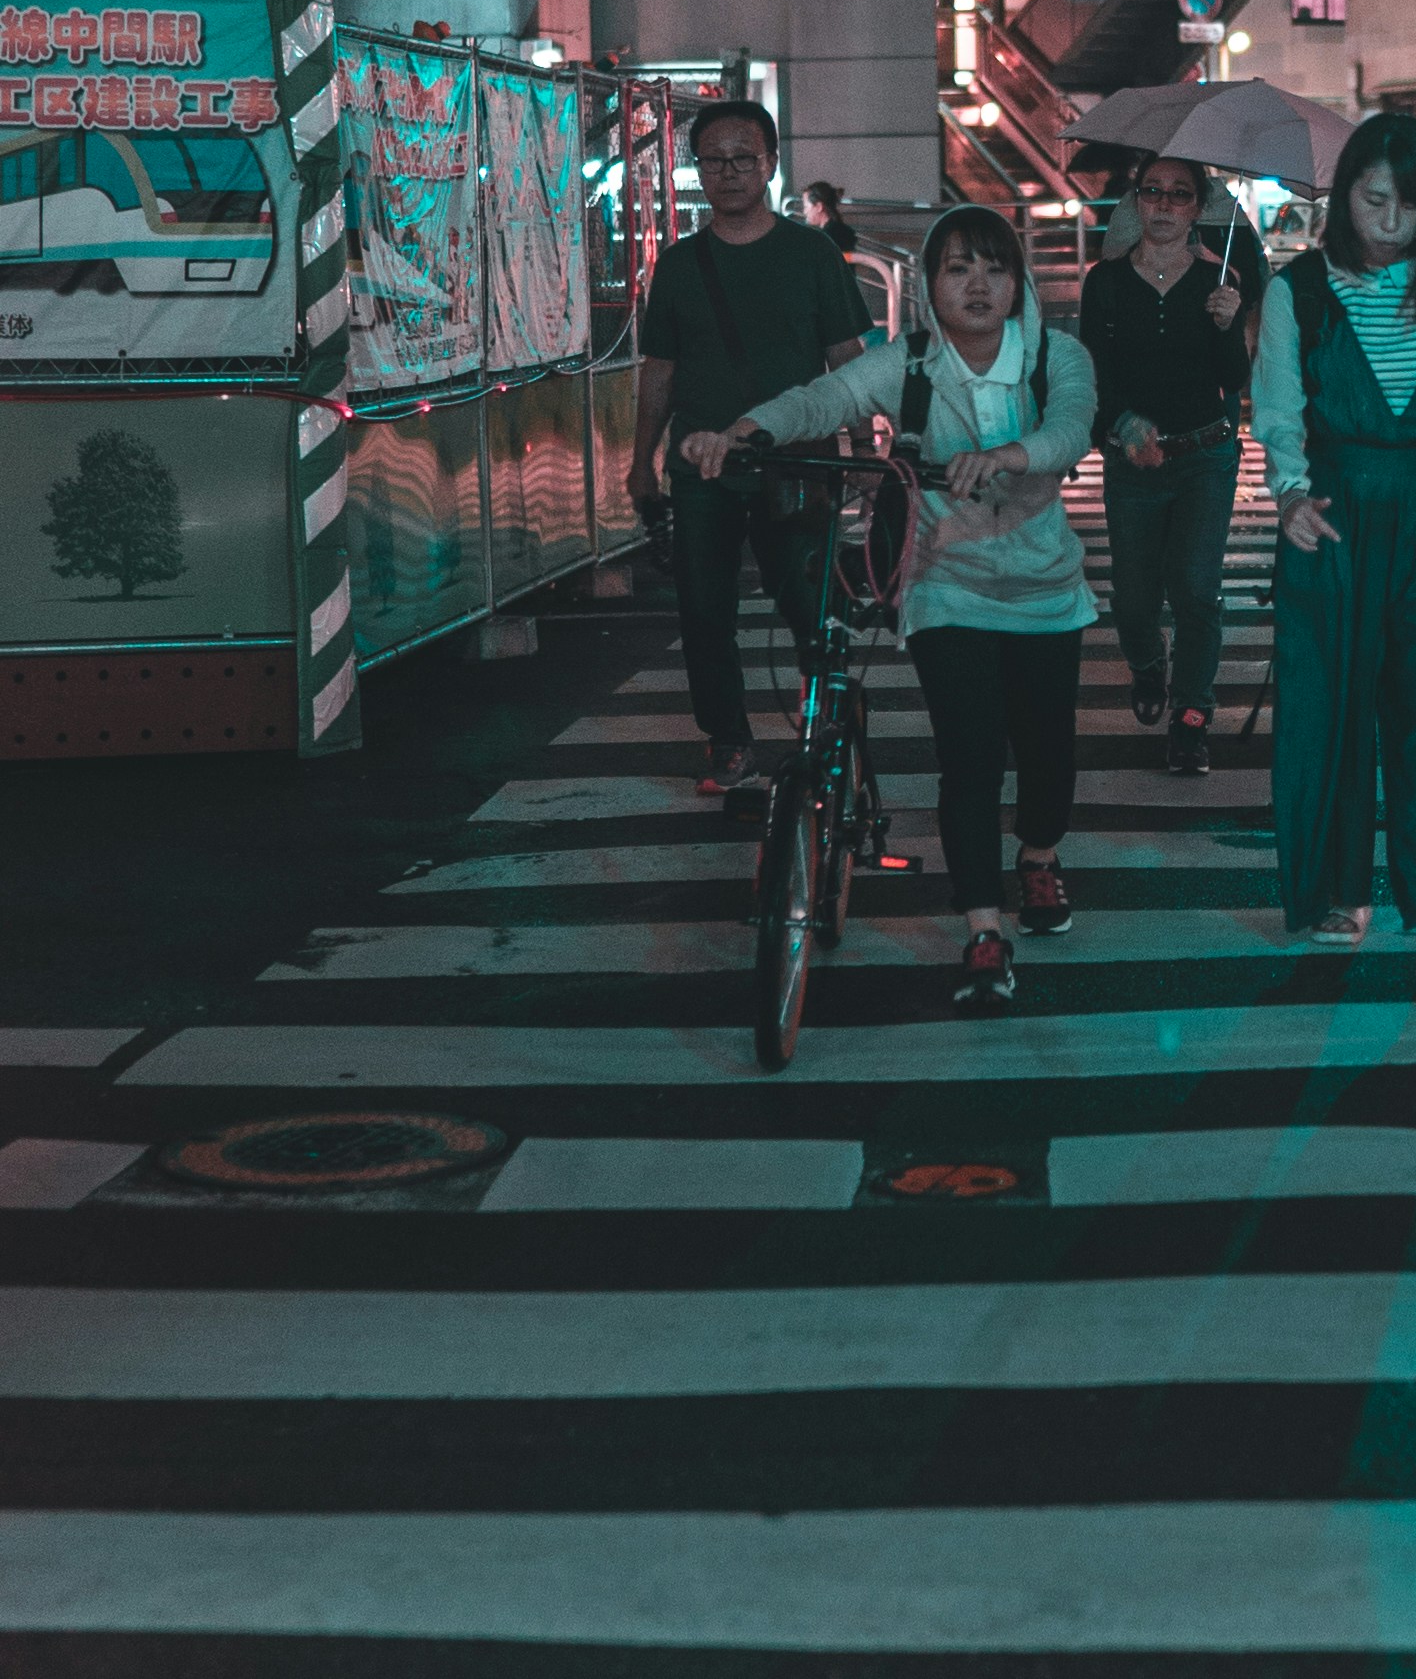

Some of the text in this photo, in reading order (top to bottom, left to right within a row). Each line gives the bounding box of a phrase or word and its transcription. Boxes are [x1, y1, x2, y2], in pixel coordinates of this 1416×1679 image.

[0, 6, 202, 65] 線中間駅
[0, 75, 280, 132] 工区建設工事
